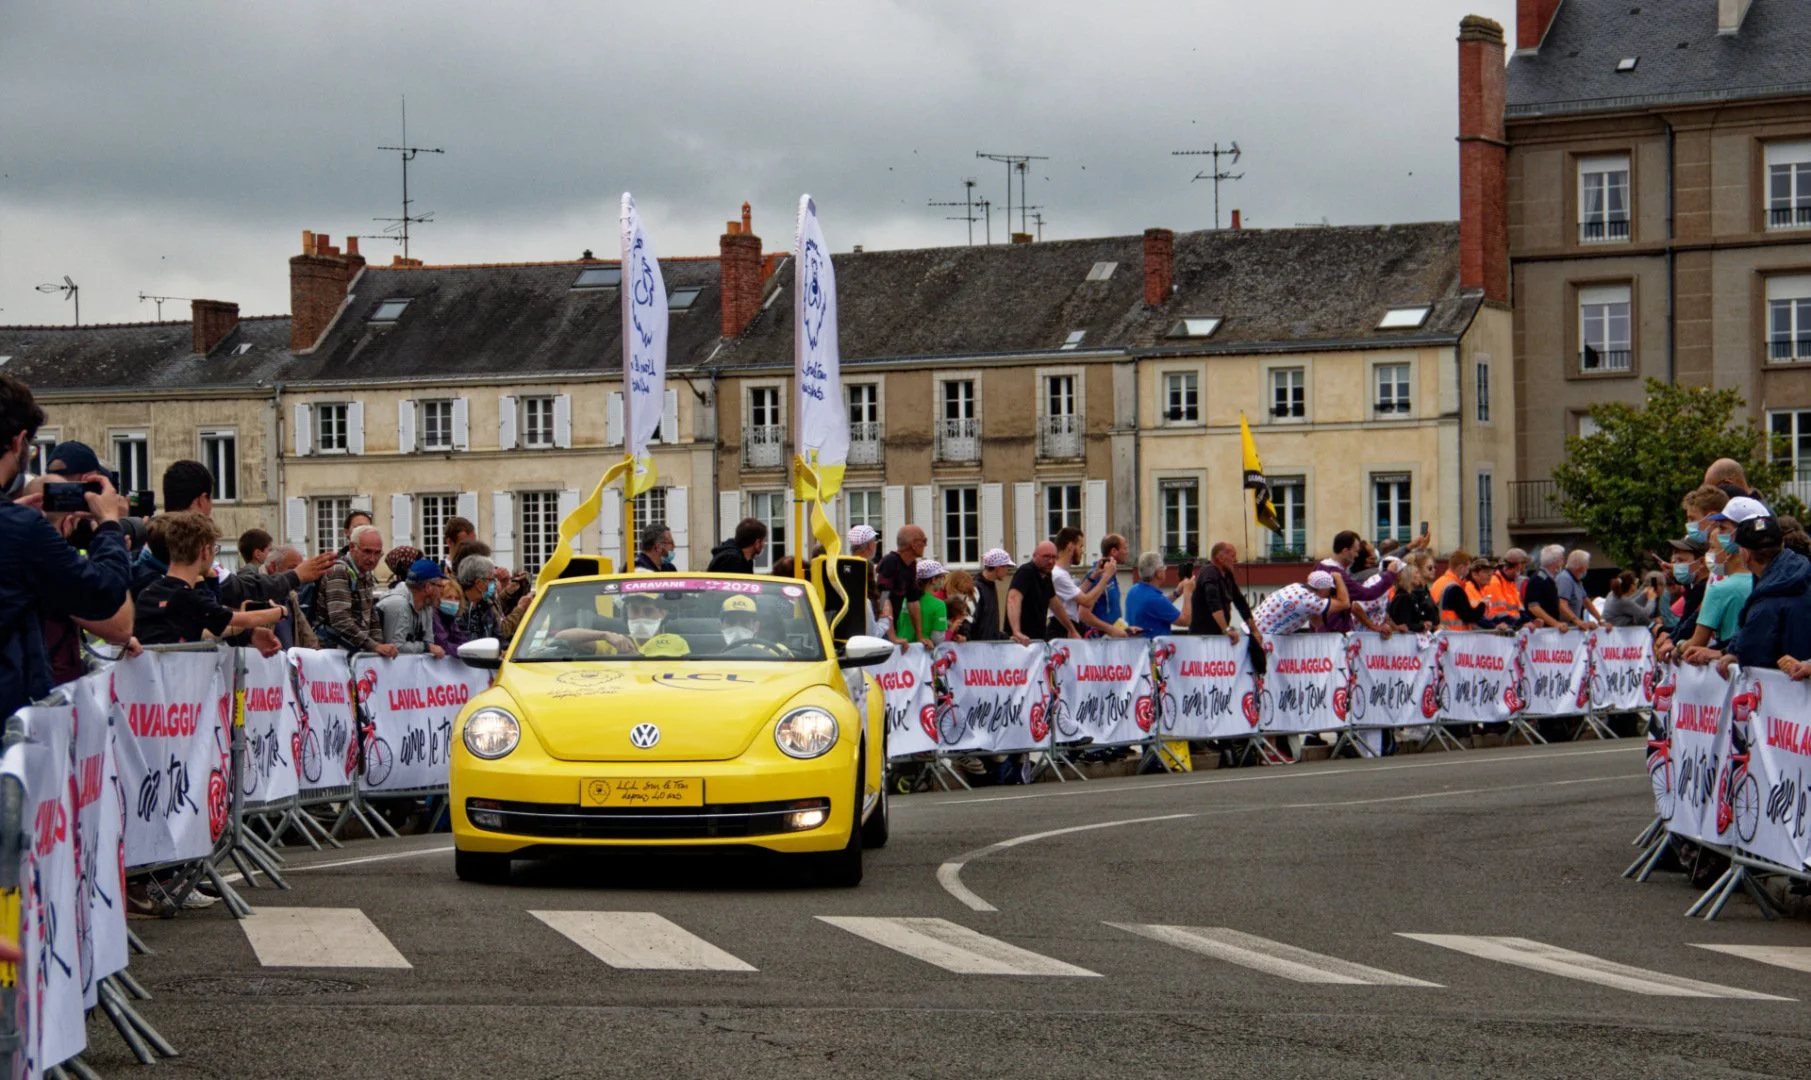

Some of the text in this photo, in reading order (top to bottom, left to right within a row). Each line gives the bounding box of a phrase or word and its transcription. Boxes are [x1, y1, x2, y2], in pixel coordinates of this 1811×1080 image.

[625, 581, 686, 590] CARAVANE
[722, 583, 760, 593] 2079
[1204, 660, 1236, 677] AGGLO
[1300, 656, 1333, 674] AGGLO
[1366, 655, 1421, 671] LAVAL AGGLO
[1475, 654, 1504, 672] AGGLO
[964, 668, 996, 686] LAVAL
[388, 683, 468, 711] LAVAL AGGLO
[631, 723, 660, 748] VW
[1767, 716, 1799, 753] LAVAL
